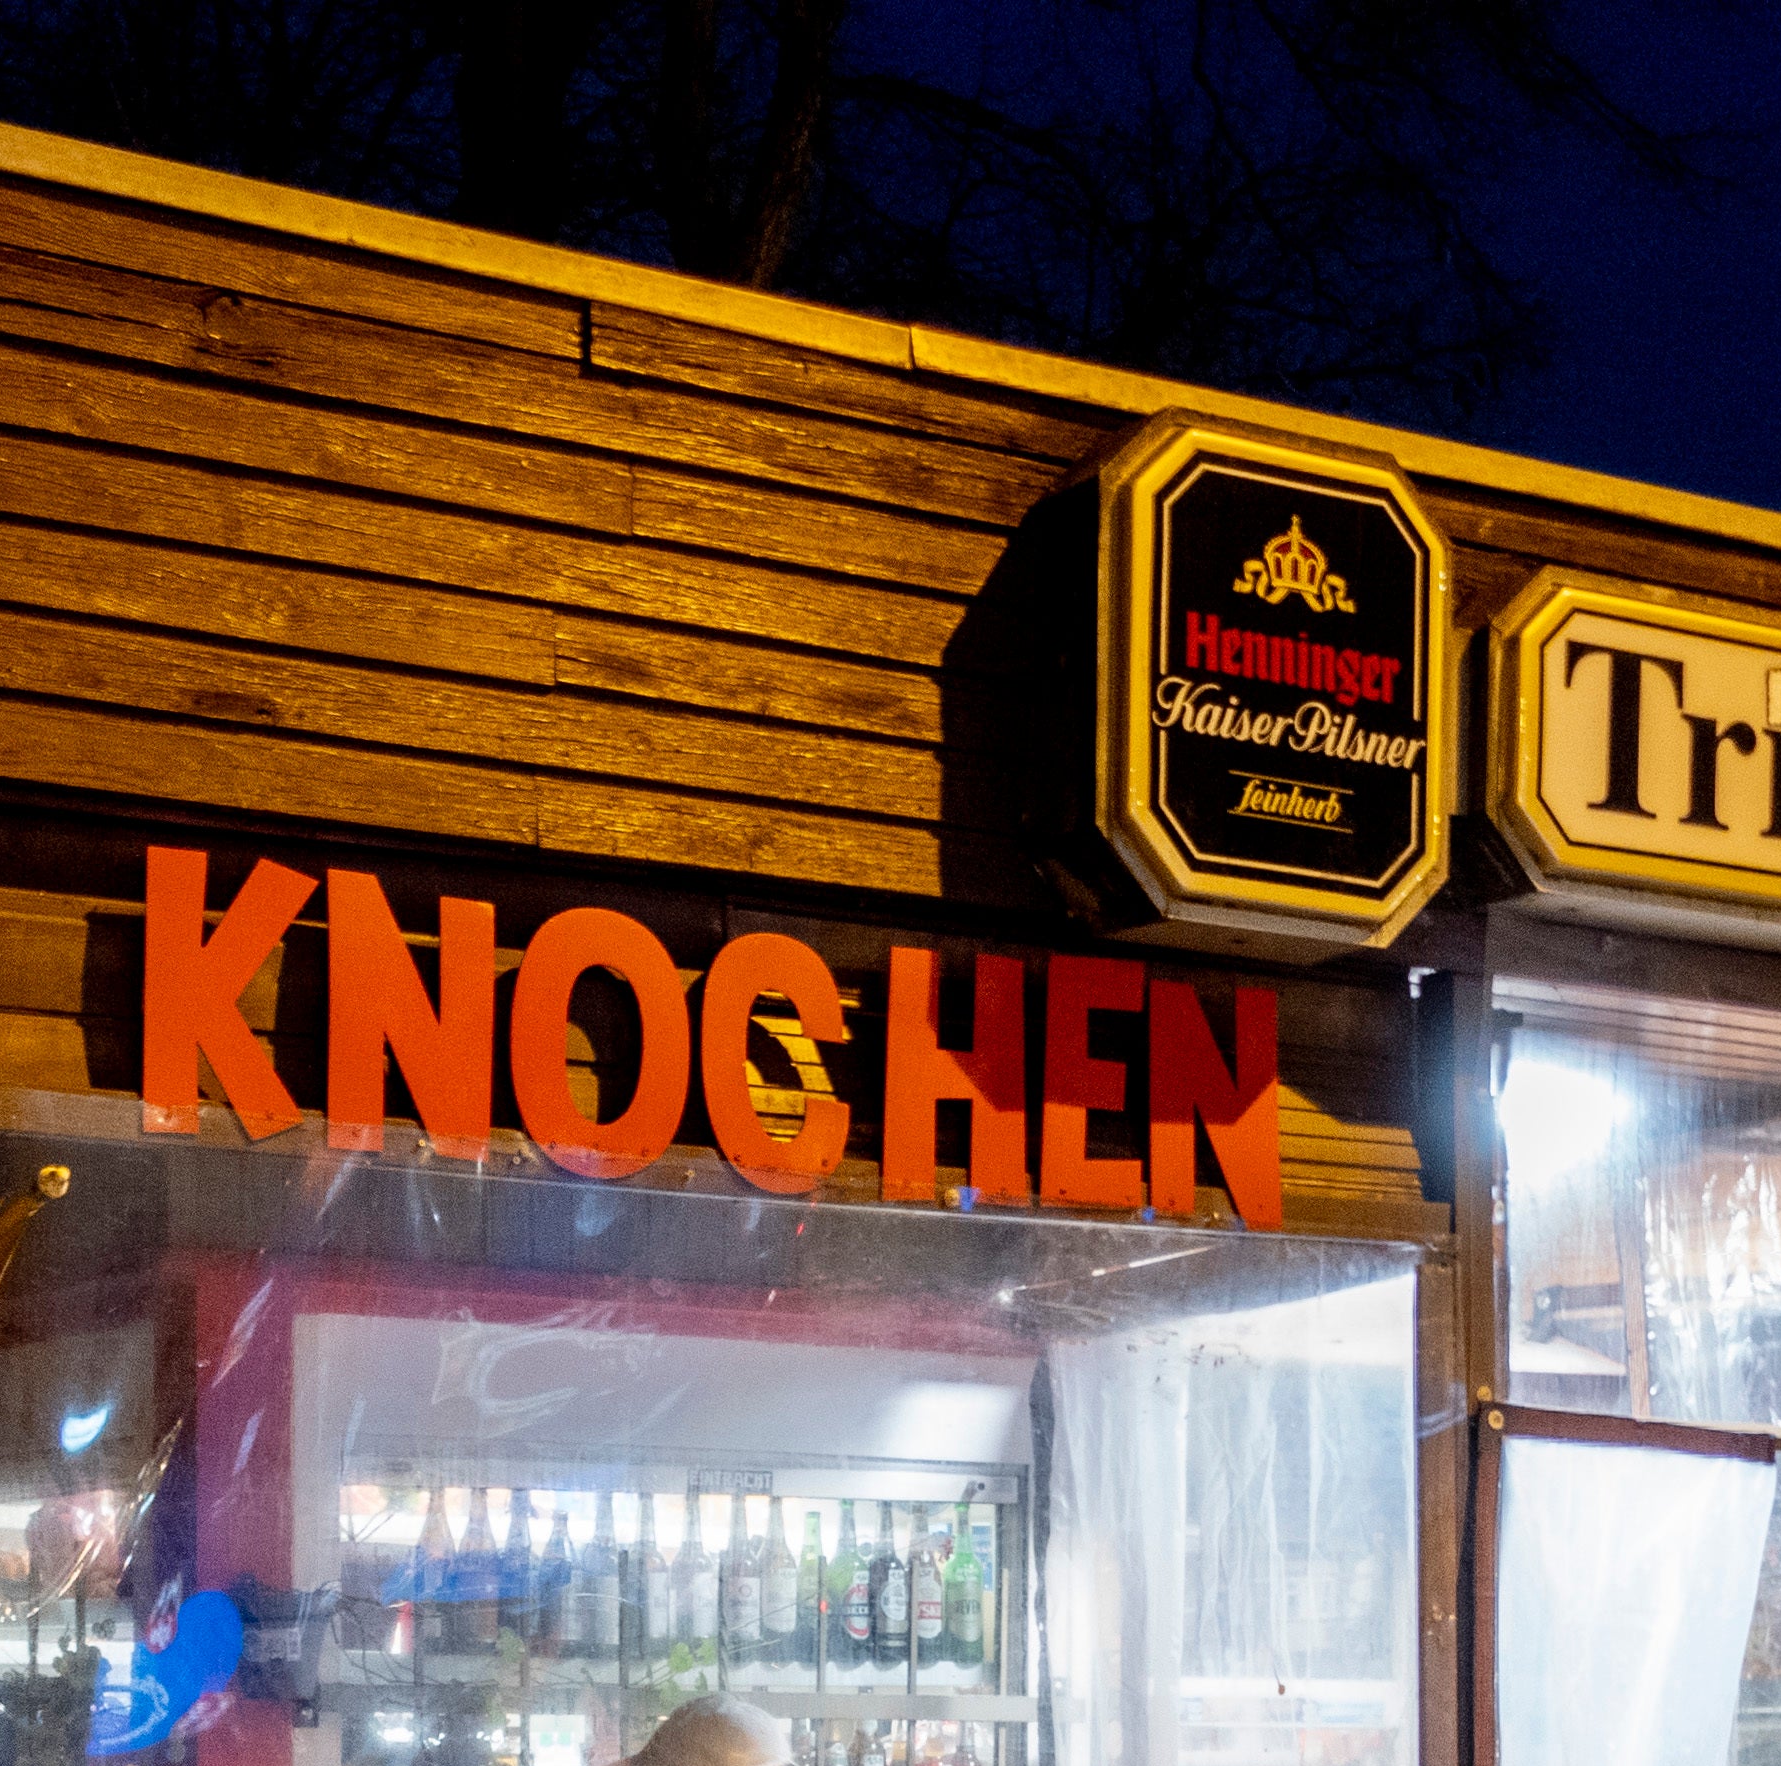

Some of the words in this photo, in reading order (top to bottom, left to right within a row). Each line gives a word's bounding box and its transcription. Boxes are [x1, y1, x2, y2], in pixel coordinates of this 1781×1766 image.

[1185, 610, 1402, 706] Henninger
[1152, 676, 1294, 746] Kaiser
[1288, 701, 1427, 769] Pilsner
[1236, 779, 1342, 823] feinherb
[142, 844, 1284, 1232] KNOCHEN
